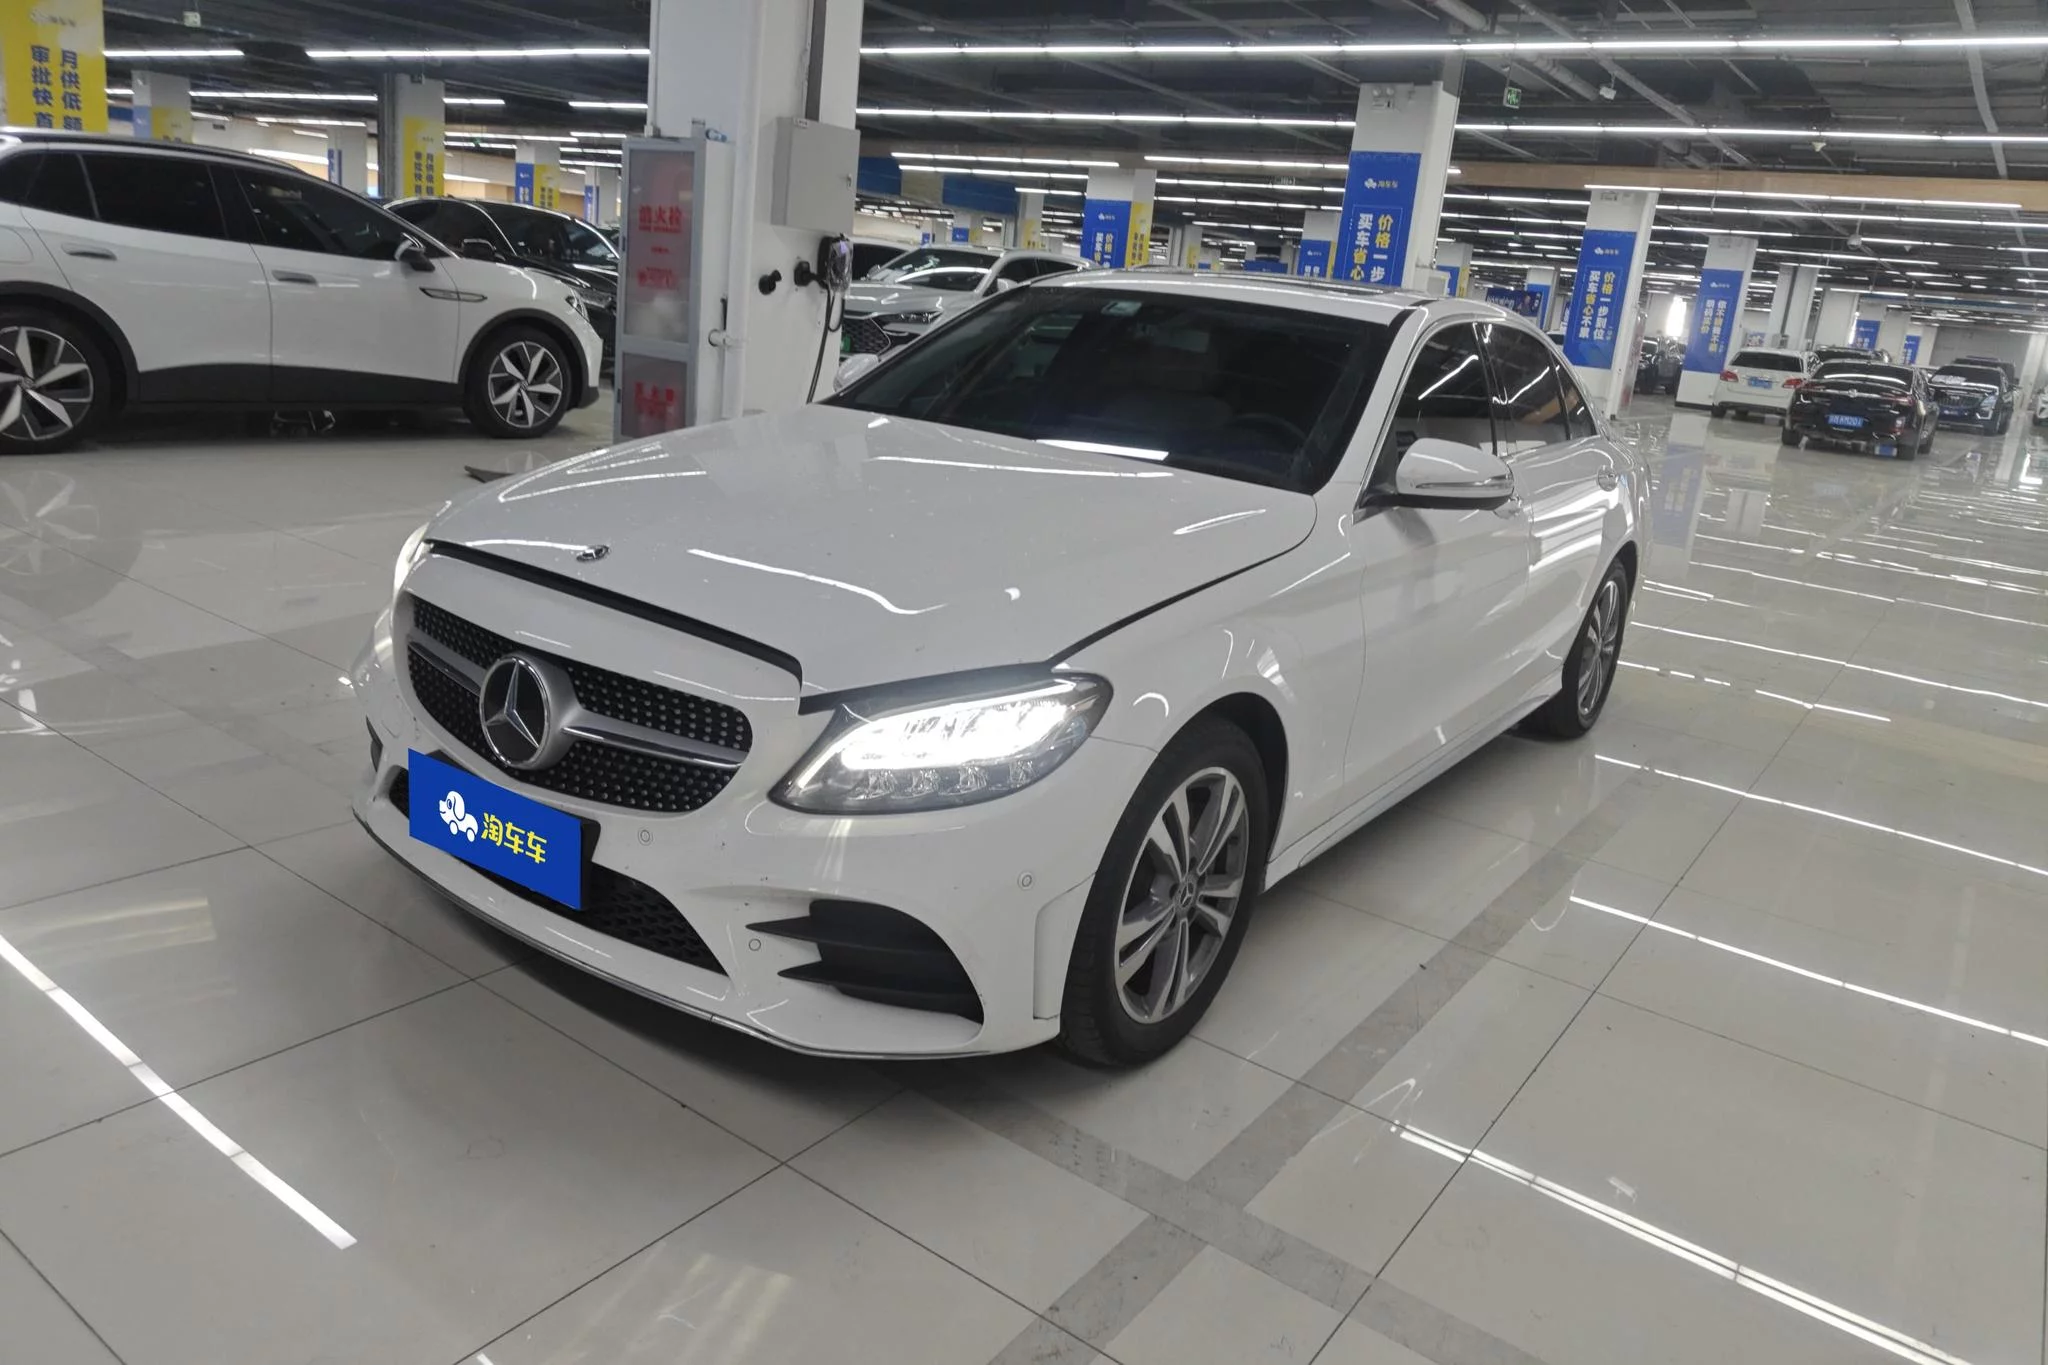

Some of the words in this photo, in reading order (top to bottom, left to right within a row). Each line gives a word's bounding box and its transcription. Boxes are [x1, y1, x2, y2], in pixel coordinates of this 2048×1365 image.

[1350, 212, 1374, 281] 买车省心
[1370, 214, 1393, 282] 价格一步
